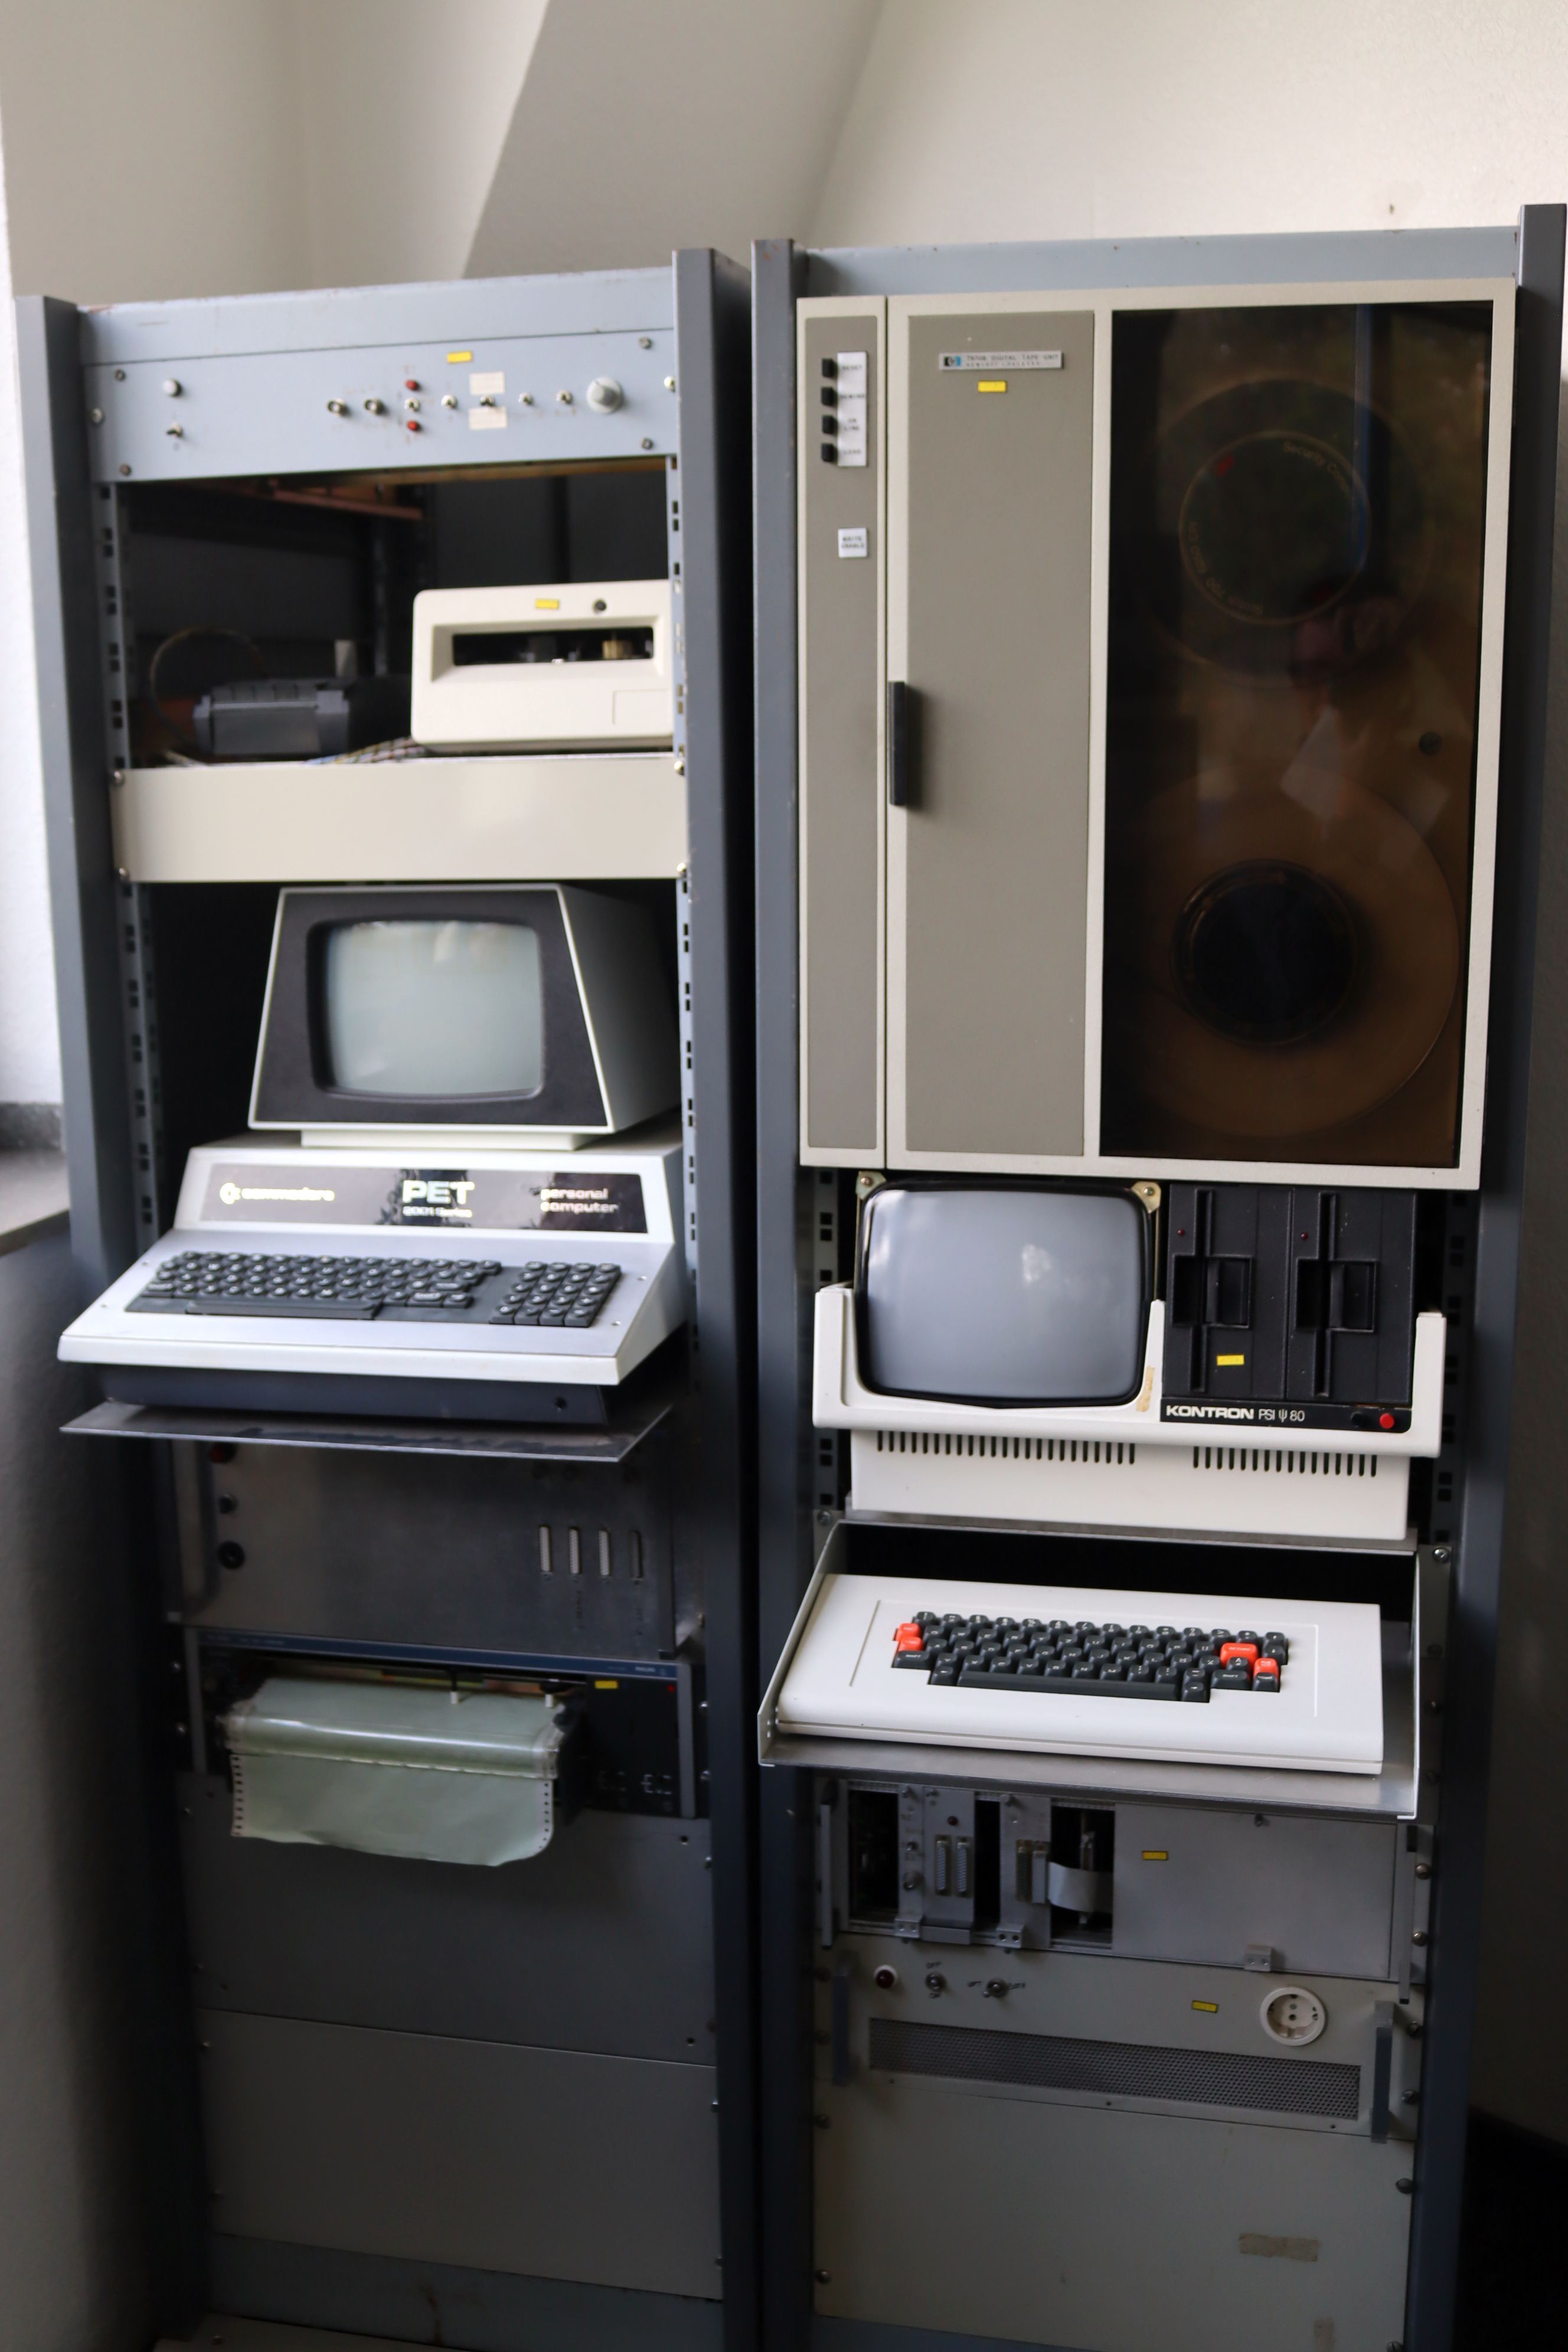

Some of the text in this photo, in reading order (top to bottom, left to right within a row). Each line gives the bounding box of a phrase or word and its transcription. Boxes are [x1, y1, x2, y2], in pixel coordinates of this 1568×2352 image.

[241, 1187, 335, 1201] commodore
[402, 1180, 475, 1205] PET
[540, 1188, 609, 1201] personal
[403, 1206, 435, 1216] 2001
[540, 1201, 619, 1214] computer
[1166, 1405, 1254, 1420] KONTRON
[1258, 1409, 1276, 1421] PSI
[1289, 1410, 1305, 1422] 80
